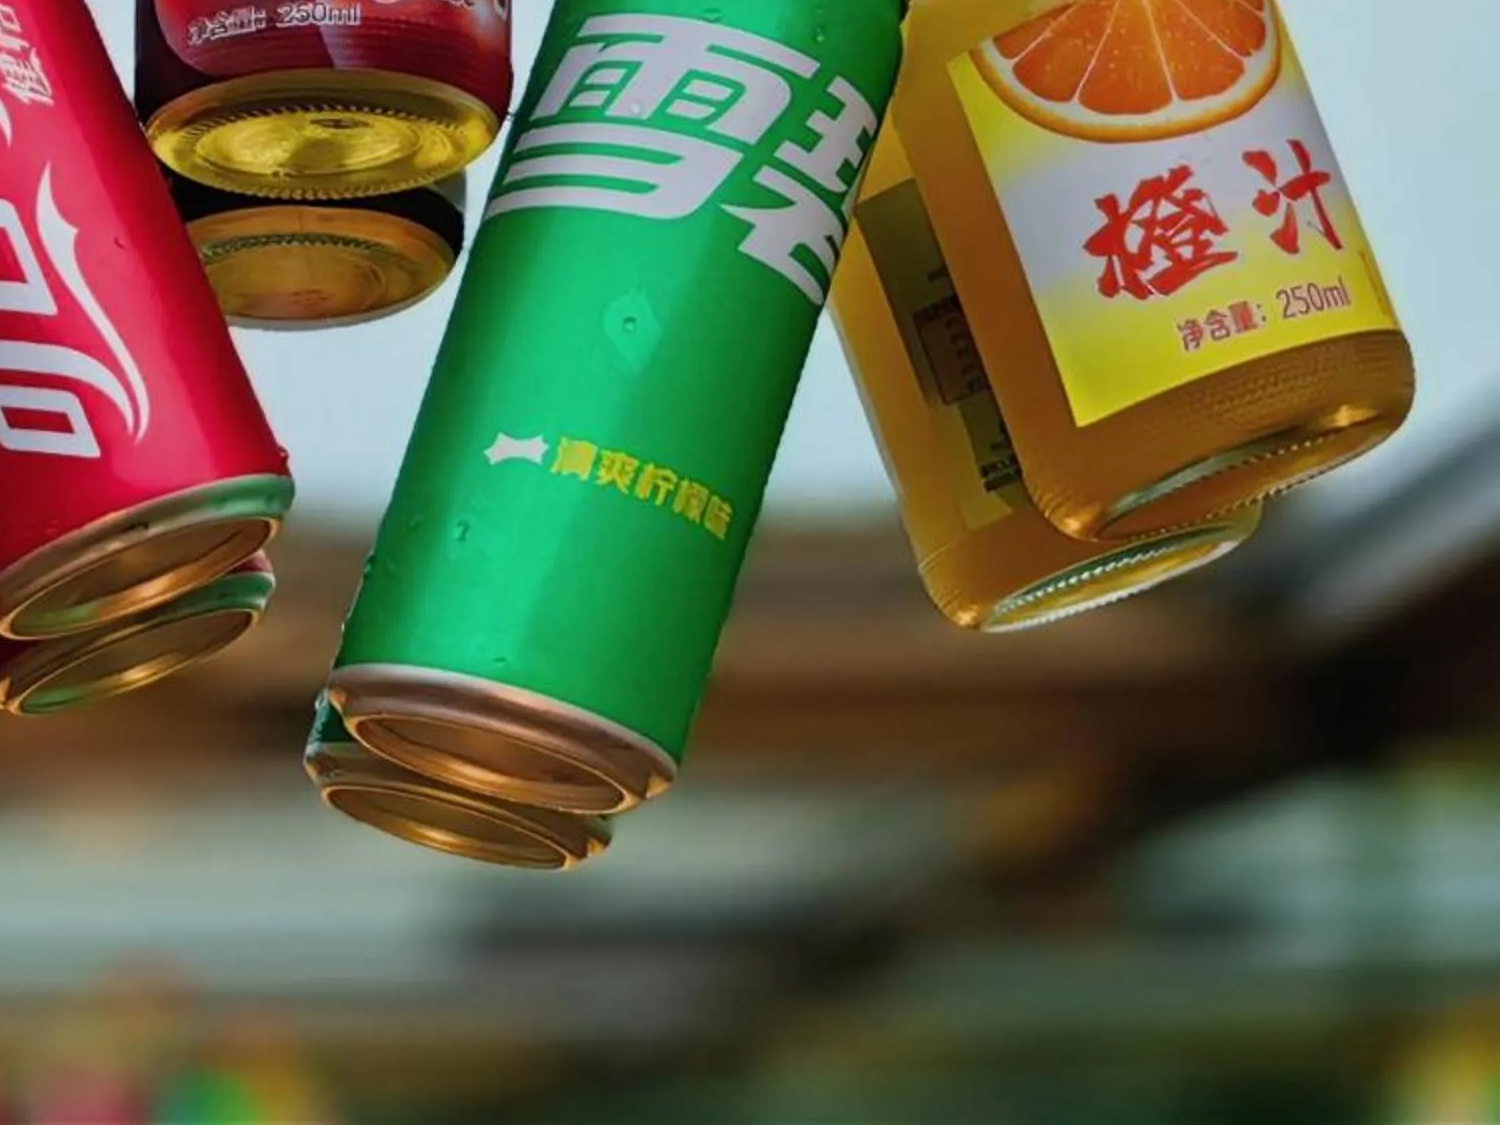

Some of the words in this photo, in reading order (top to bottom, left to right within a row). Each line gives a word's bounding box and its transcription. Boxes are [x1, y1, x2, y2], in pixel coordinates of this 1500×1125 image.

[484, 13, 880, 306] 雪碧
[1082, 139, 1345, 301] 橙汁
[1276, 276, 1352, 320] 250ml
